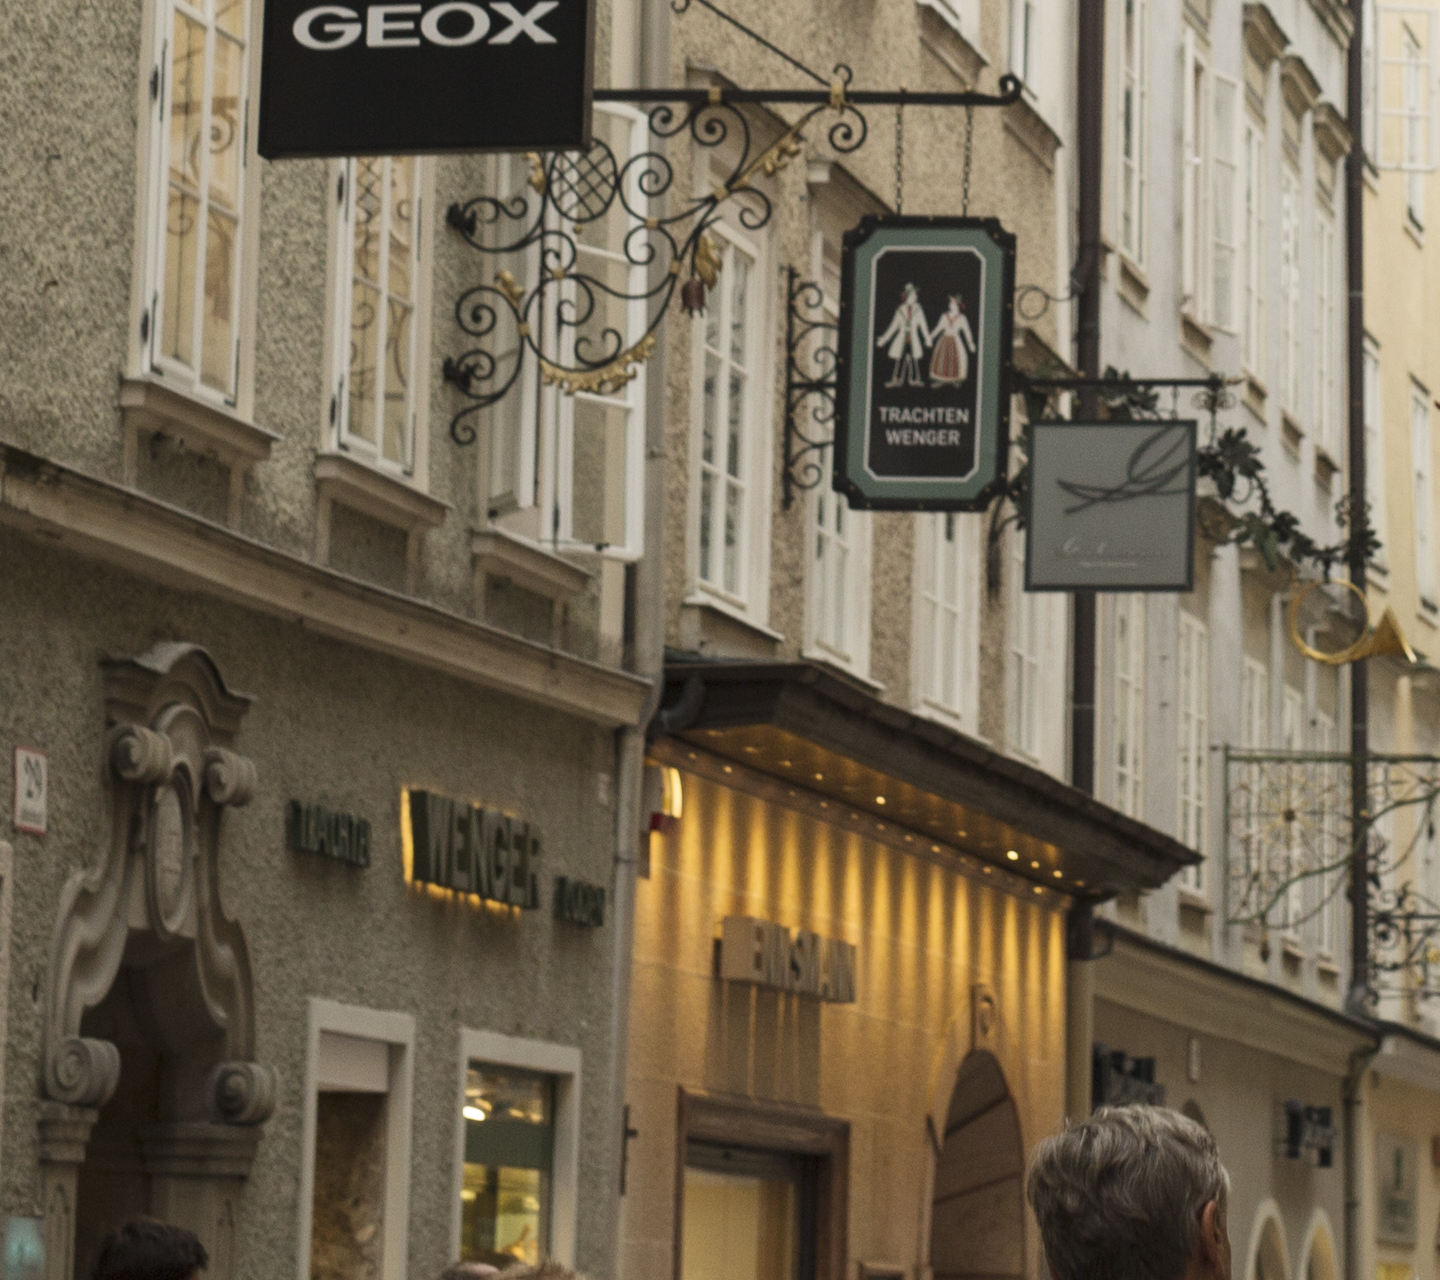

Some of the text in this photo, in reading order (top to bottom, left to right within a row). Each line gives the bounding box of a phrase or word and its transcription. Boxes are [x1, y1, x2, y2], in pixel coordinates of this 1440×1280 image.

[291, 1, 560, 50] GEOX
[878, 406, 970, 425] TRACHTEN
[885, 427, 962, 447] WENGER
